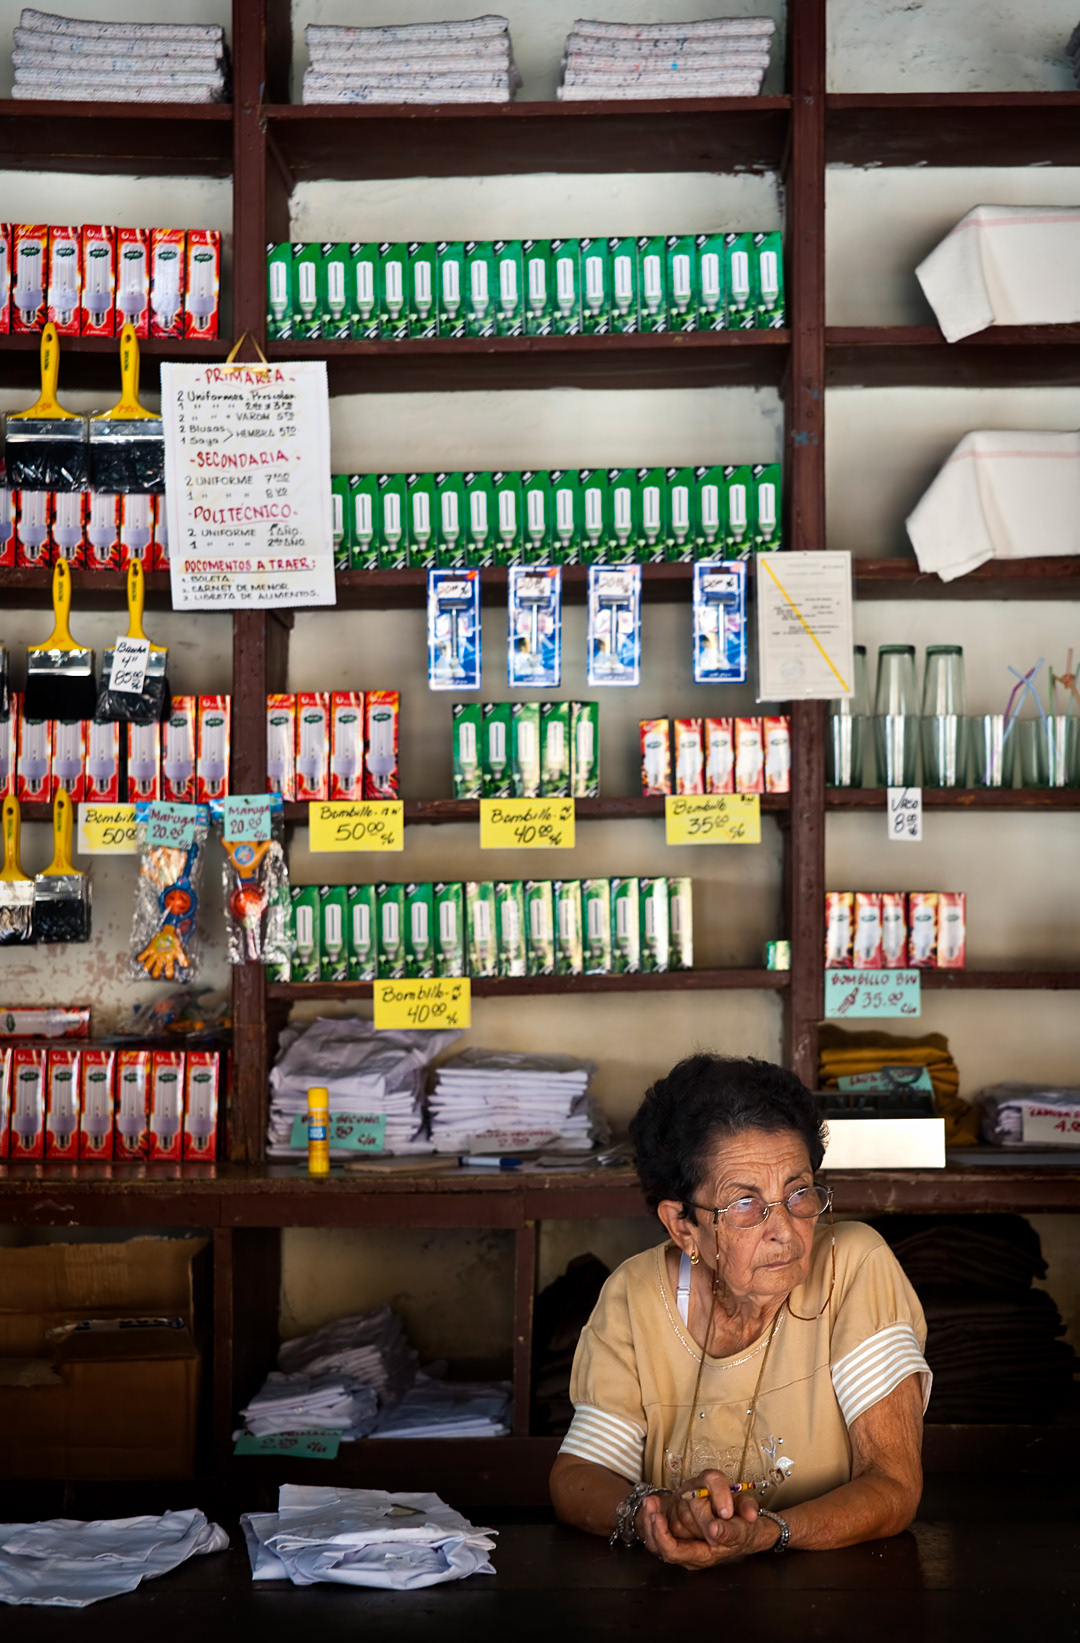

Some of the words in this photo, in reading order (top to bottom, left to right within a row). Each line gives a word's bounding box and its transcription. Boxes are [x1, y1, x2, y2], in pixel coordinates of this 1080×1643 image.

[177, 390, 185, 402] 2
[189, 424, 226, 434] Blusas
[189, 436, 220, 447] Saya
[185, 475, 193, 487] 2
[195, 475, 254, 486] UNIFORME
[201, 528, 257, 537] UNIFORME
[257, 560, 266, 570] A
[192, 584, 233, 593] CARNET
[236, 583, 248, 592] DE
[250, 582, 289, 592] MENOR
[241, 592, 253, 600] DE
[85, 809, 136, 824] Bombill
